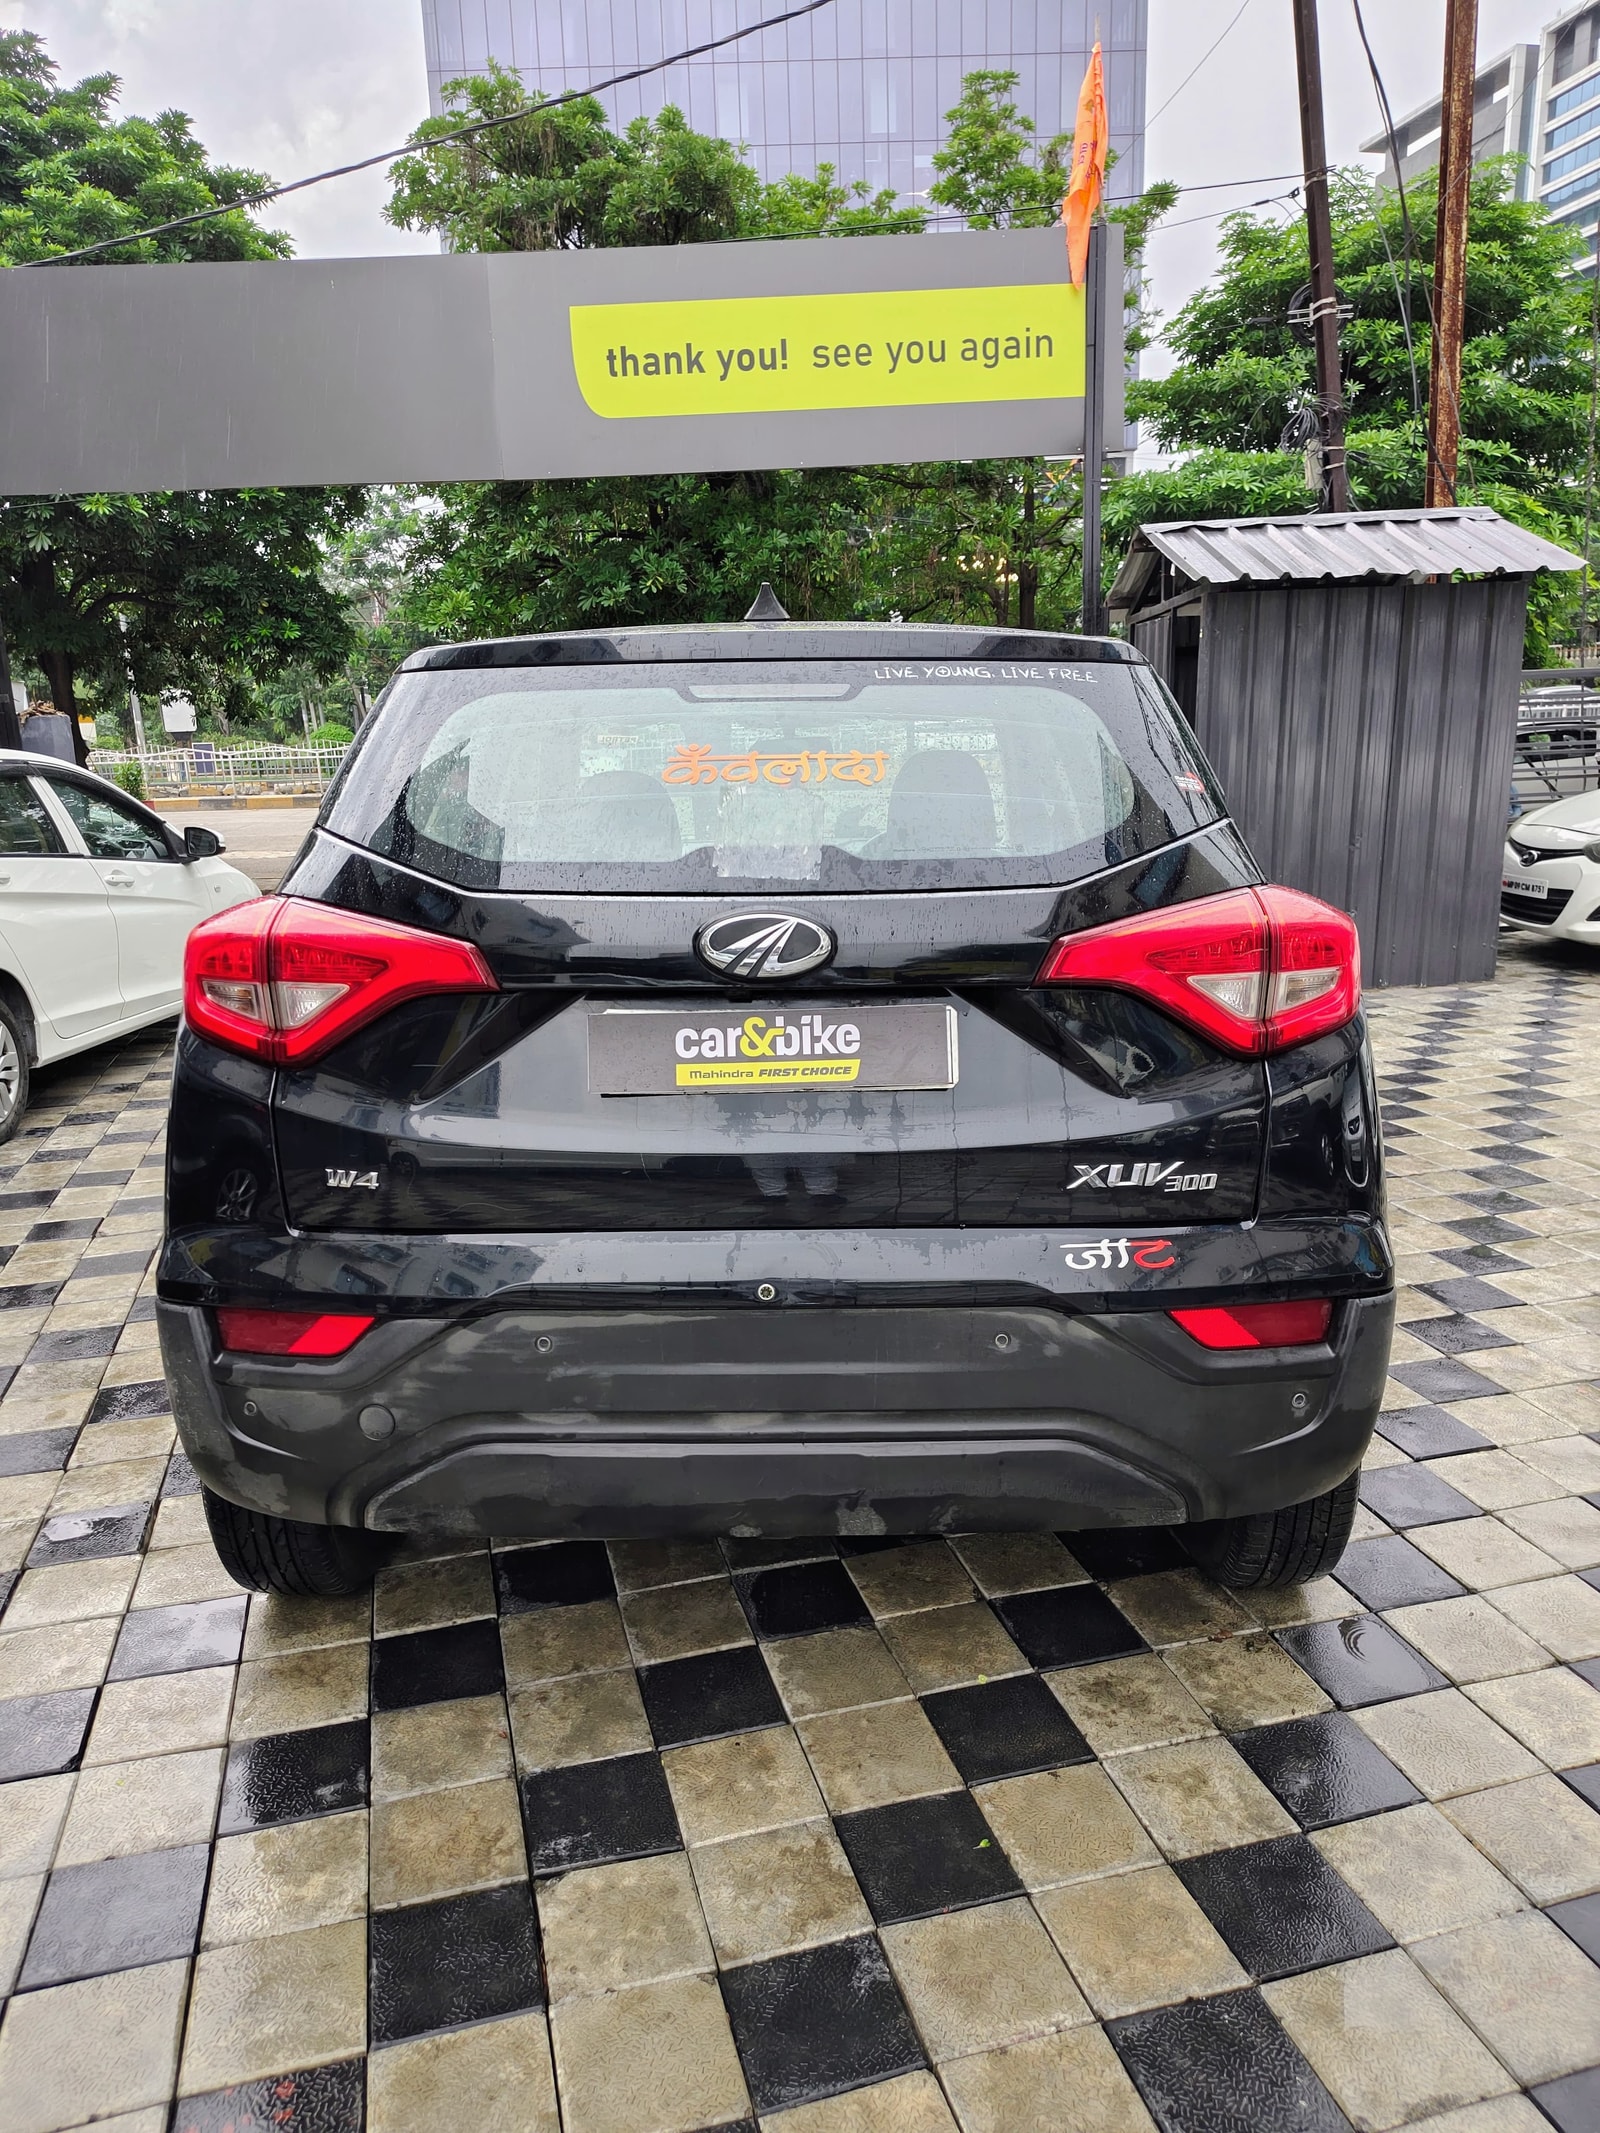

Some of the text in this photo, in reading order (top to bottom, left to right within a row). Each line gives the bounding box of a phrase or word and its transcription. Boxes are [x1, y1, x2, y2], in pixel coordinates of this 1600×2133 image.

[606, 327, 1054, 382] thank you! see you again
[874, 665, 1099, 683] LIVE YOUNG. LIVE FREE
[1521, 883, 1530, 891] CM
[674, 1014, 861, 1059] car&bike
[689, 1066, 852, 1080] Mahindra FIRST CHOICE
[325, 1168, 380, 1190] W4
[1059, 1237, 1176, 1270] जाट
